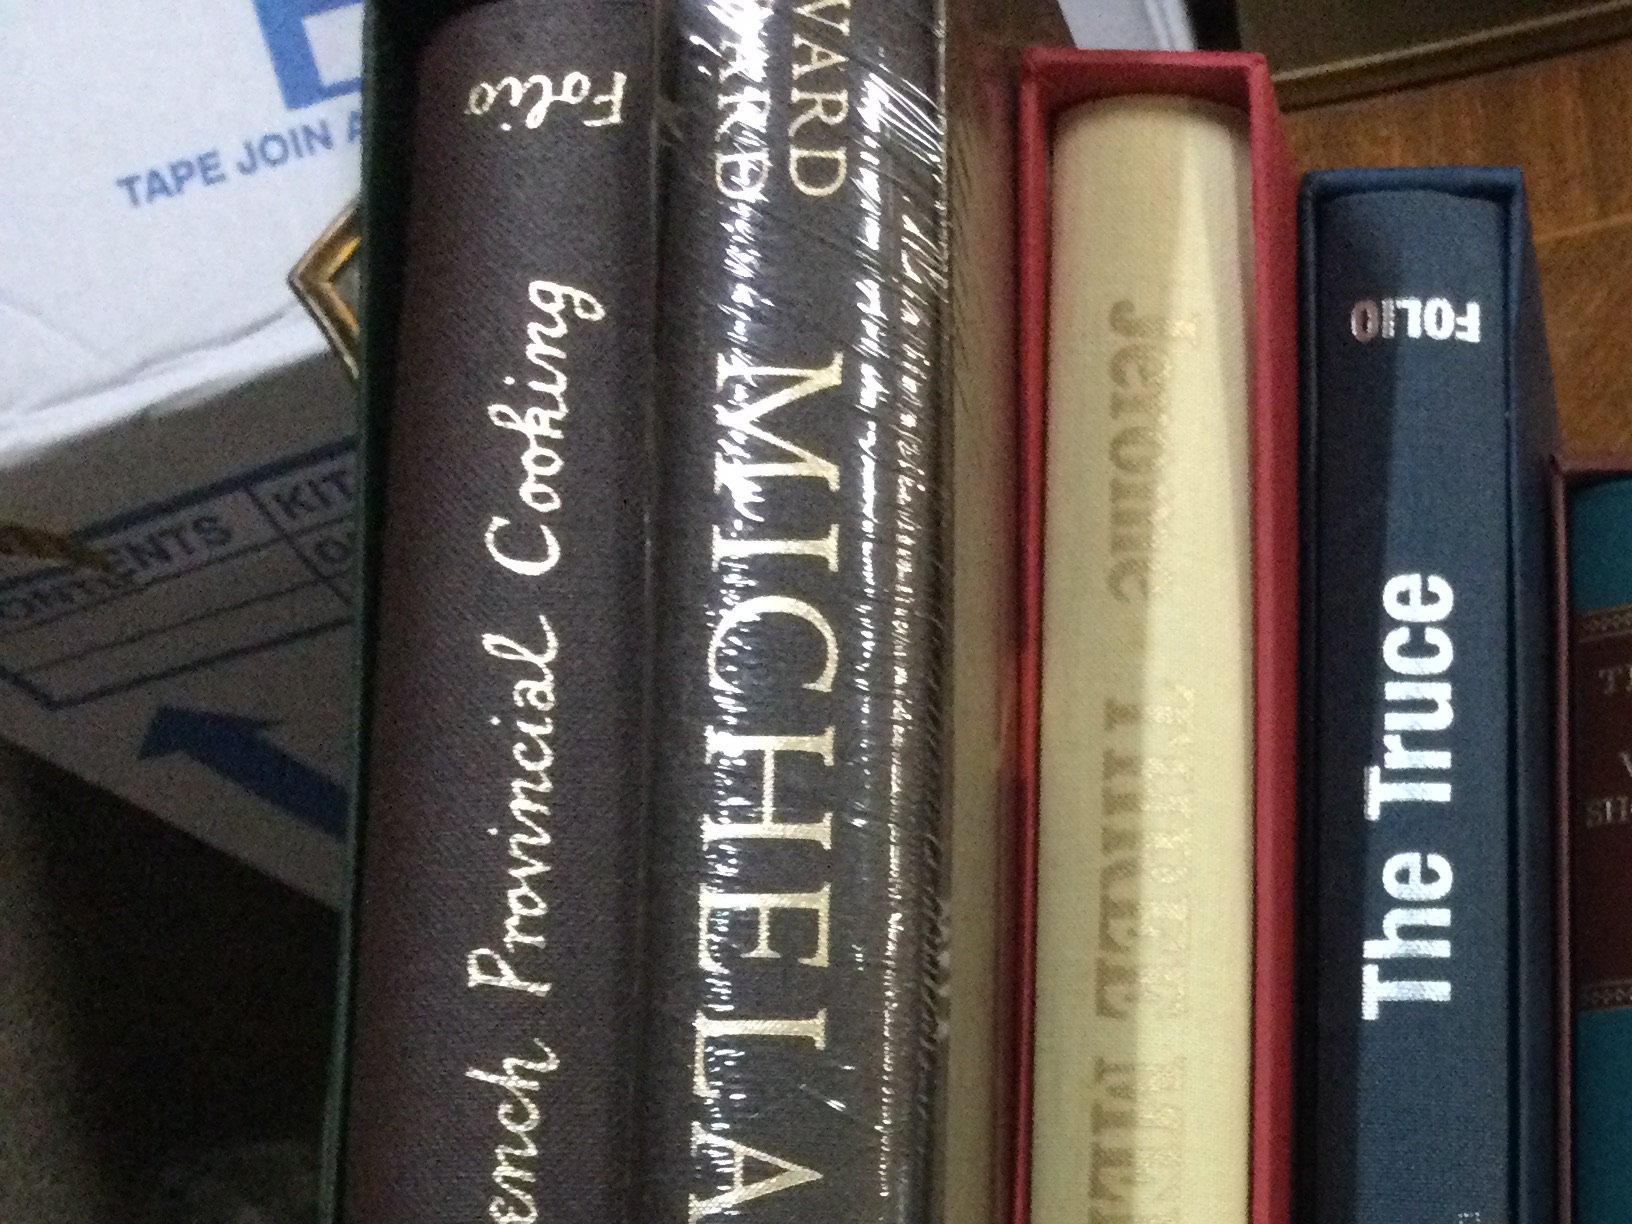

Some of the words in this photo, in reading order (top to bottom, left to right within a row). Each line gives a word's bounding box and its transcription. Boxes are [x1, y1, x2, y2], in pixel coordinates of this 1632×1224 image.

[116, 150, 228, 208] TAPE
[236, 119, 334, 176] JOIN
[465, 70, 628, 130] Folio
[484, 279, 605, 576] Cooking
[1350, 297, 1481, 344] FOLIO
[1106, 298, 1203, 605] Jerome
[466, 613, 560, 998] Provincial
[1363, 572, 1455, 822] Truce
[1094, 682, 1198, 1024] THREE
[1360, 849, 1454, 1021] The
